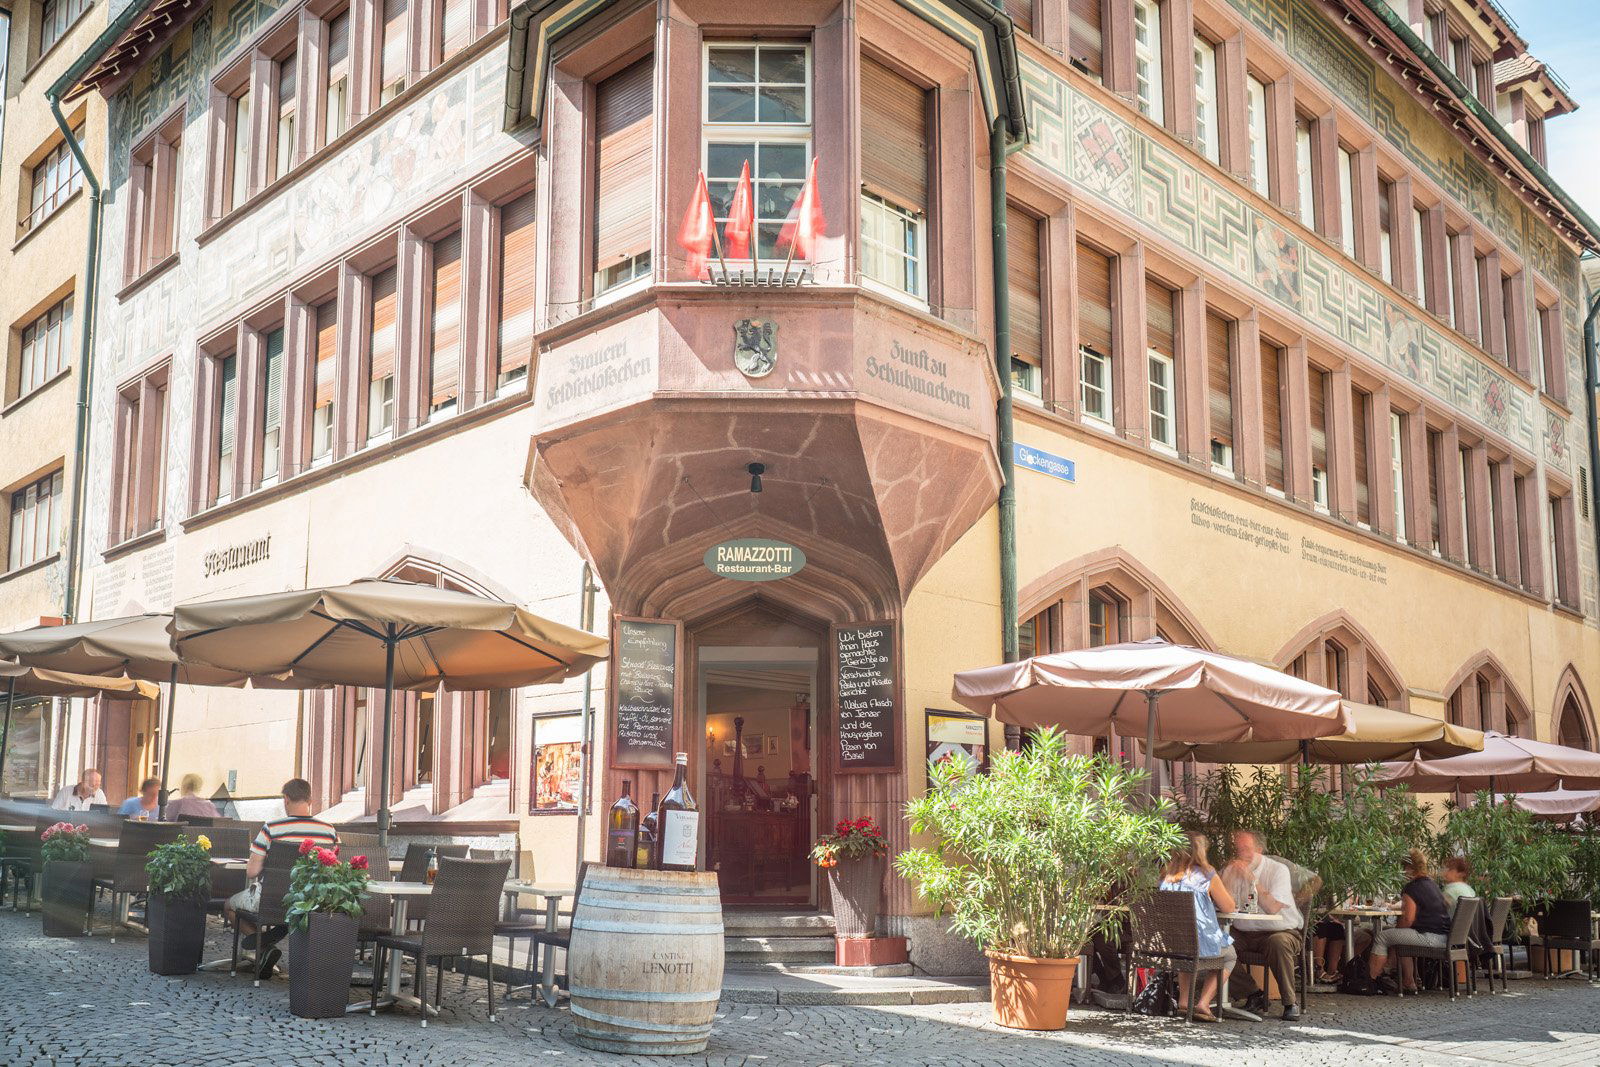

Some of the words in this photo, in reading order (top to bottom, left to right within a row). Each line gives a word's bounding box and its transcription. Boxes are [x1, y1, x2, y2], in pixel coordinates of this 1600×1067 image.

[568, 338, 628, 374] Brauerei
[890, 340, 929, 371] Zunft
[931, 358, 947, 378] zu
[865, 356, 971, 409] Schuhmachern
[1019, 447, 1069, 475] Glckengasse
[204, 532, 271, 579] Restaurant
[717, 546, 792, 562] RAMAZZOTTI
[717, 563, 792, 573] Restaurant-Bar
[622, 625, 647, 636] Unsere
[838, 631, 855, 643] Wir
[857, 629, 883, 640] bieten
[861, 639, 879, 650] Haus
[847, 655, 878, 666] Gerichte
[878, 655, 889, 663] an
[839, 679, 857, 690] Pasta
[857, 678, 870, 688] und
[871, 676, 893, 686] Risotto
[840, 688, 867, 697] Gerichte
[859, 720, 872, 729] die
[863, 742, 877, 750] von
[841, 750, 865, 760] Basel
[642, 962, 694, 975] LENOTTI
